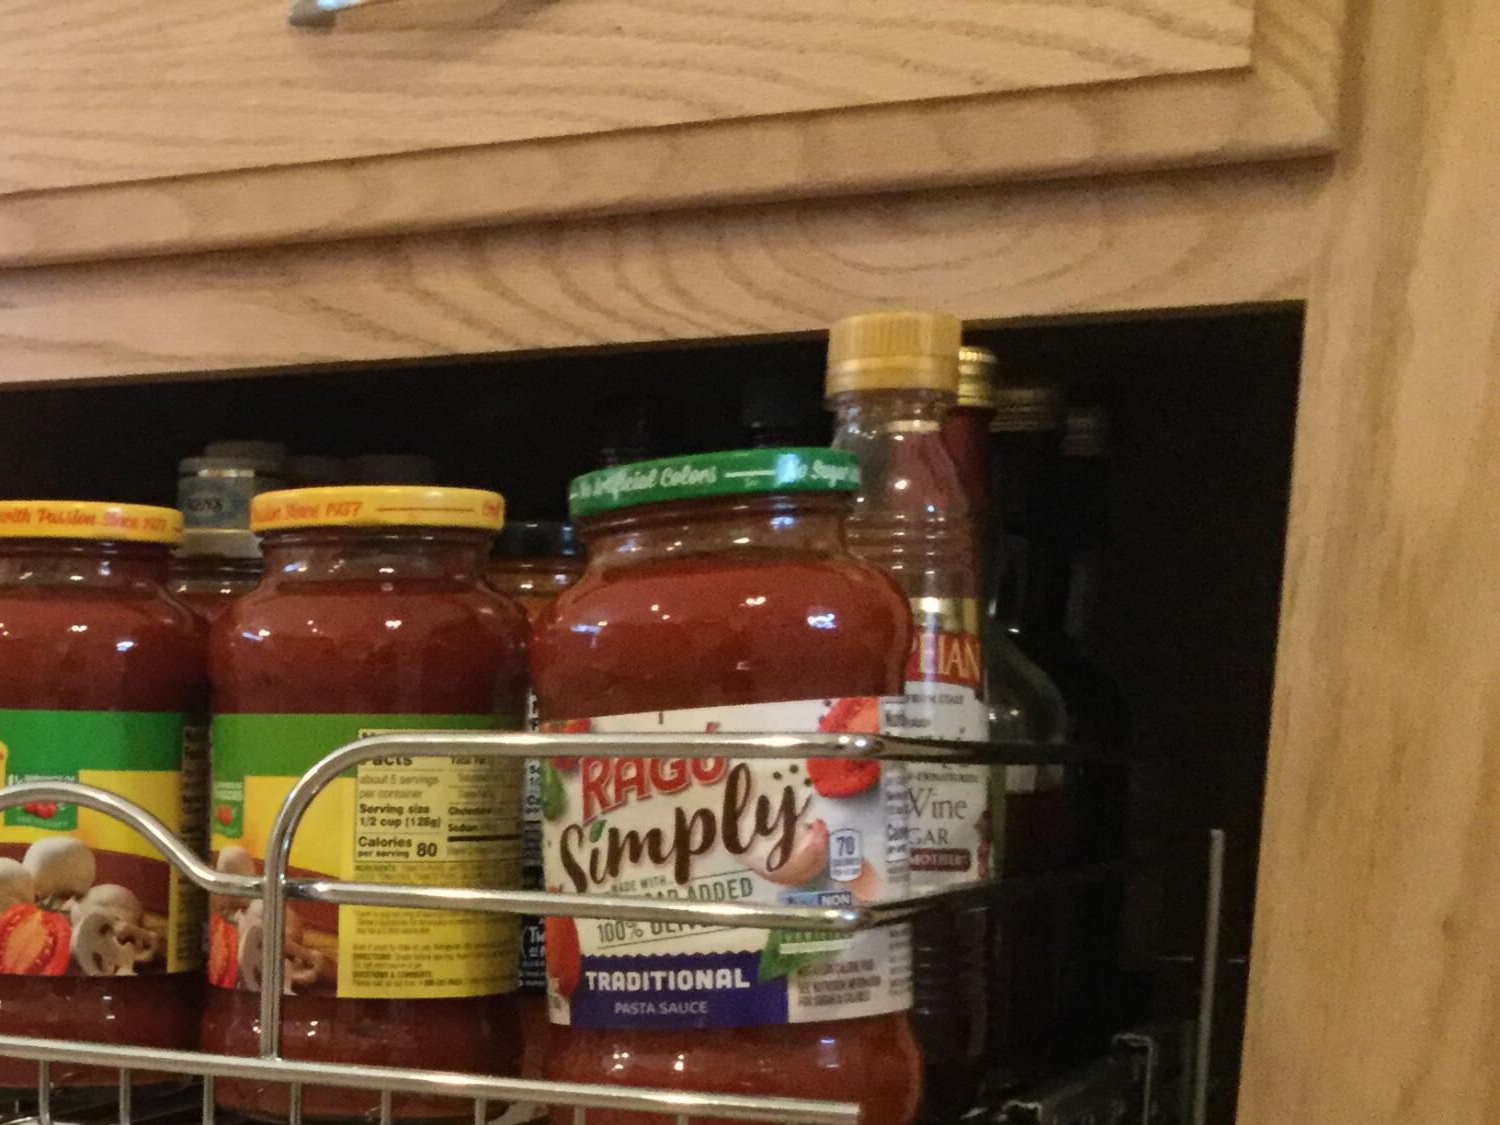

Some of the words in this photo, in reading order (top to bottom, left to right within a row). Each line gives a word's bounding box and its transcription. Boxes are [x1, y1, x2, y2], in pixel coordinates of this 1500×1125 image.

[660, 466, 717, 486] Colors
[325, 501, 363, 518] 1937
[359, 804, 404, 816] Serving
[408, 804, 430, 815] size
[360, 816, 377, 827] 1/2
[380, 818, 403, 829] cup
[406, 816, 441, 829] (128g)
[560, 763, 812, 893] Simply
[358, 836, 413, 848] Calories
[417, 842, 438, 858] 80
[376, 850, 410, 860] serving
[836, 835, 855, 857] 70
[688, 878, 754, 900] ADDED
[597, 921, 644, 943] 100%
[585, 967, 750, 992] TRADITIONAL
[614, 1001, 656, 1015] PASTA
[659, 1000, 708, 1014] SAUCE
